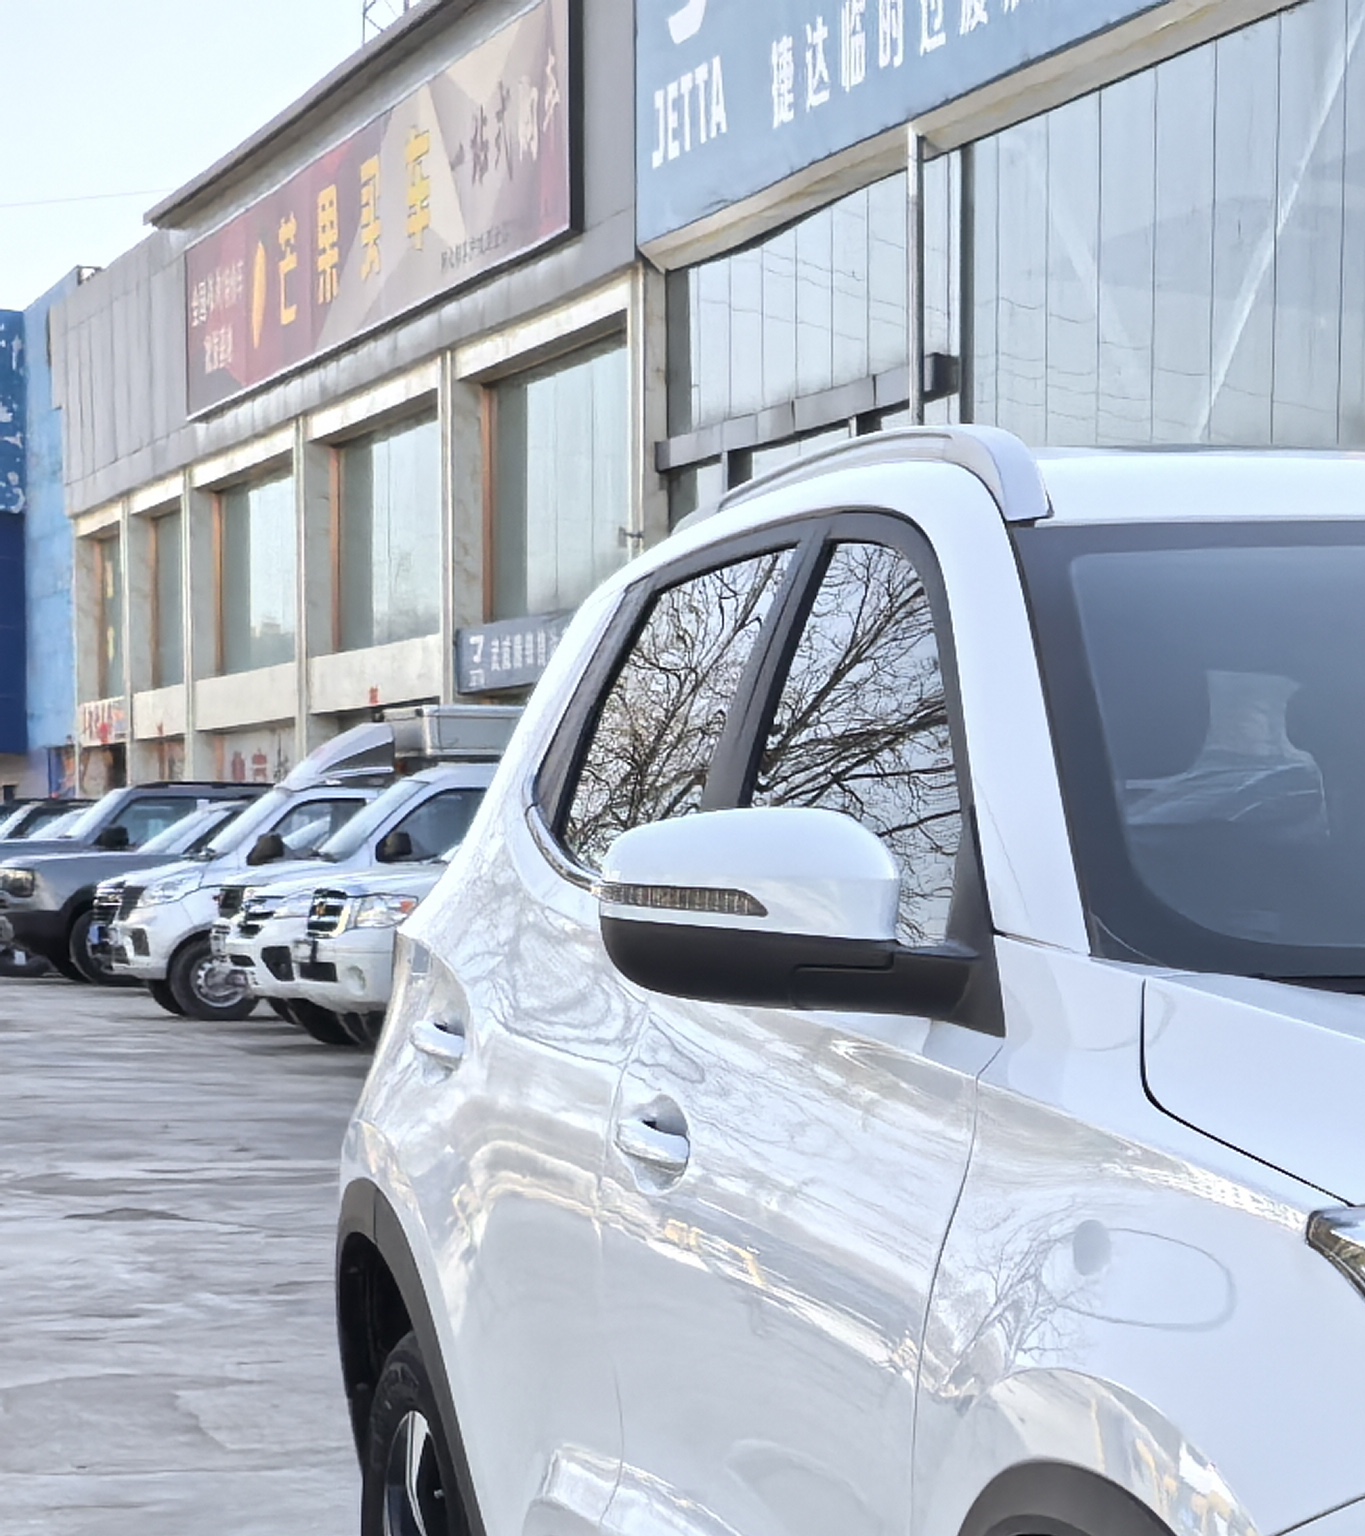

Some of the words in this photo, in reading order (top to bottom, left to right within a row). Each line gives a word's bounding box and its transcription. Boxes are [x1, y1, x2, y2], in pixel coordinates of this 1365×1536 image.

[651, 55, 727, 169] JETTA
[770, 0, 1020, 129] 捷达临时过
[278, 125, 431, 326] 芒果买车
